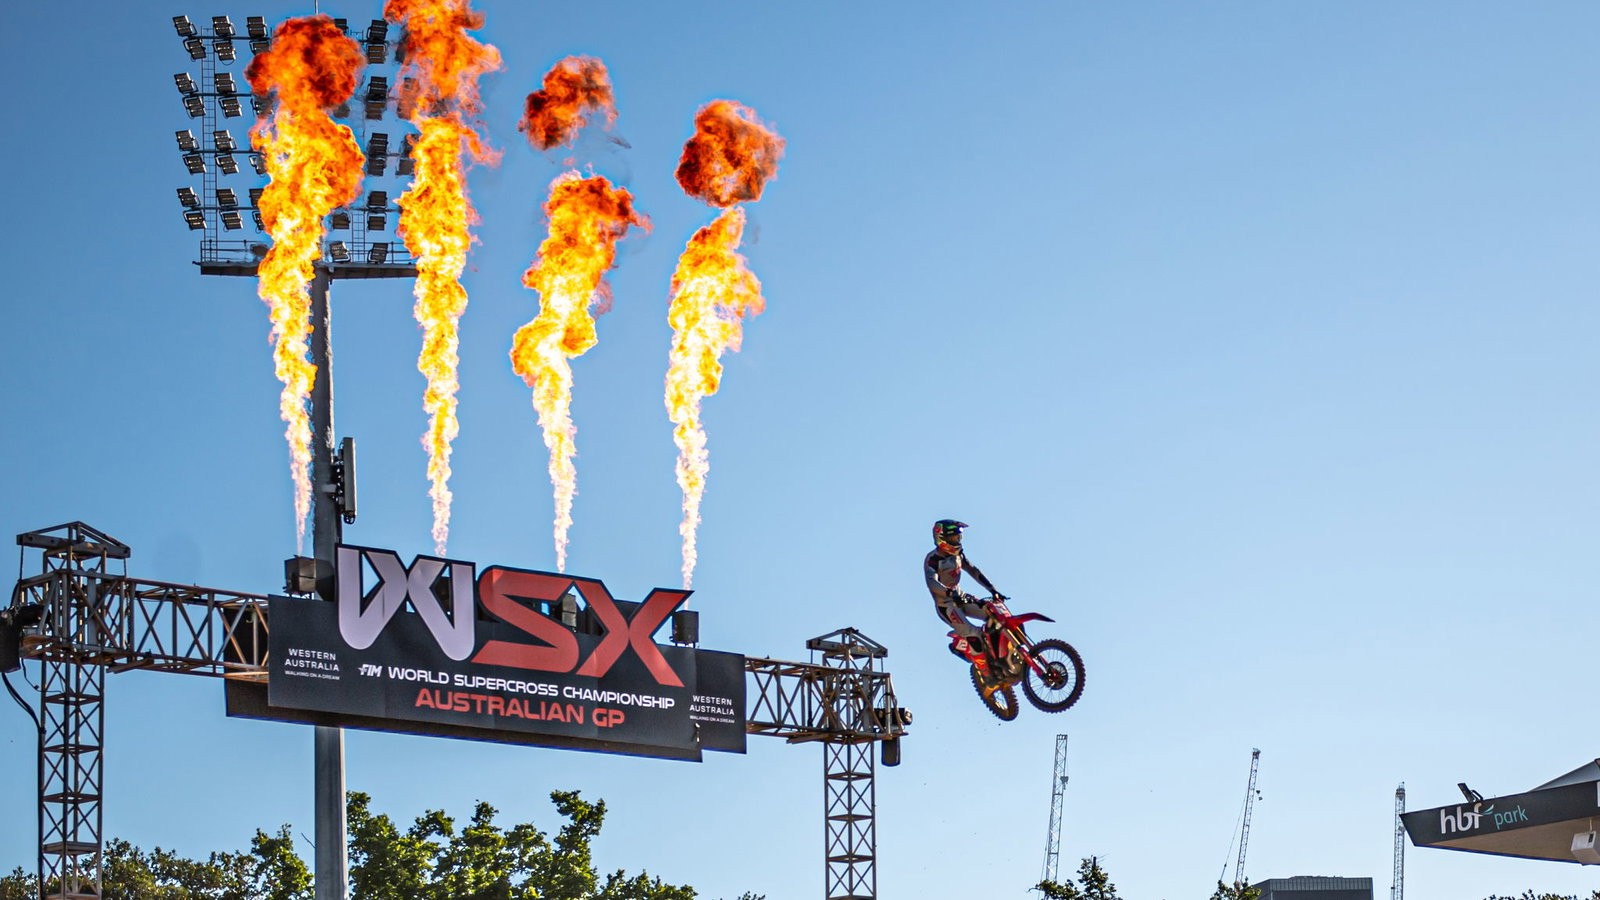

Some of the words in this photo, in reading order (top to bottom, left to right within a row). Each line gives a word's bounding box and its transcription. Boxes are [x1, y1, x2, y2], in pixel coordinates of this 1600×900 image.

[337, 545, 694, 687] WSX
[284, 658, 340, 671] AUSTRALIA
[288, 648, 336, 660] WESTERN
[357, 663, 382, 677] FIM
[388, 666, 449, 685] WORLD
[454, 674, 559, 697] SUPERCROSS
[563, 686, 675, 709] CHAMPIONSHIP
[415, 688, 584, 725] AUSTRALIAN
[592, 708, 625, 728] GP
[689, 705, 735, 715] AUSTRALIA
[692, 695, 732, 705] WESTERN
[1440, 802, 1483, 834] hbf
[1494, 805, 1528, 829] park
